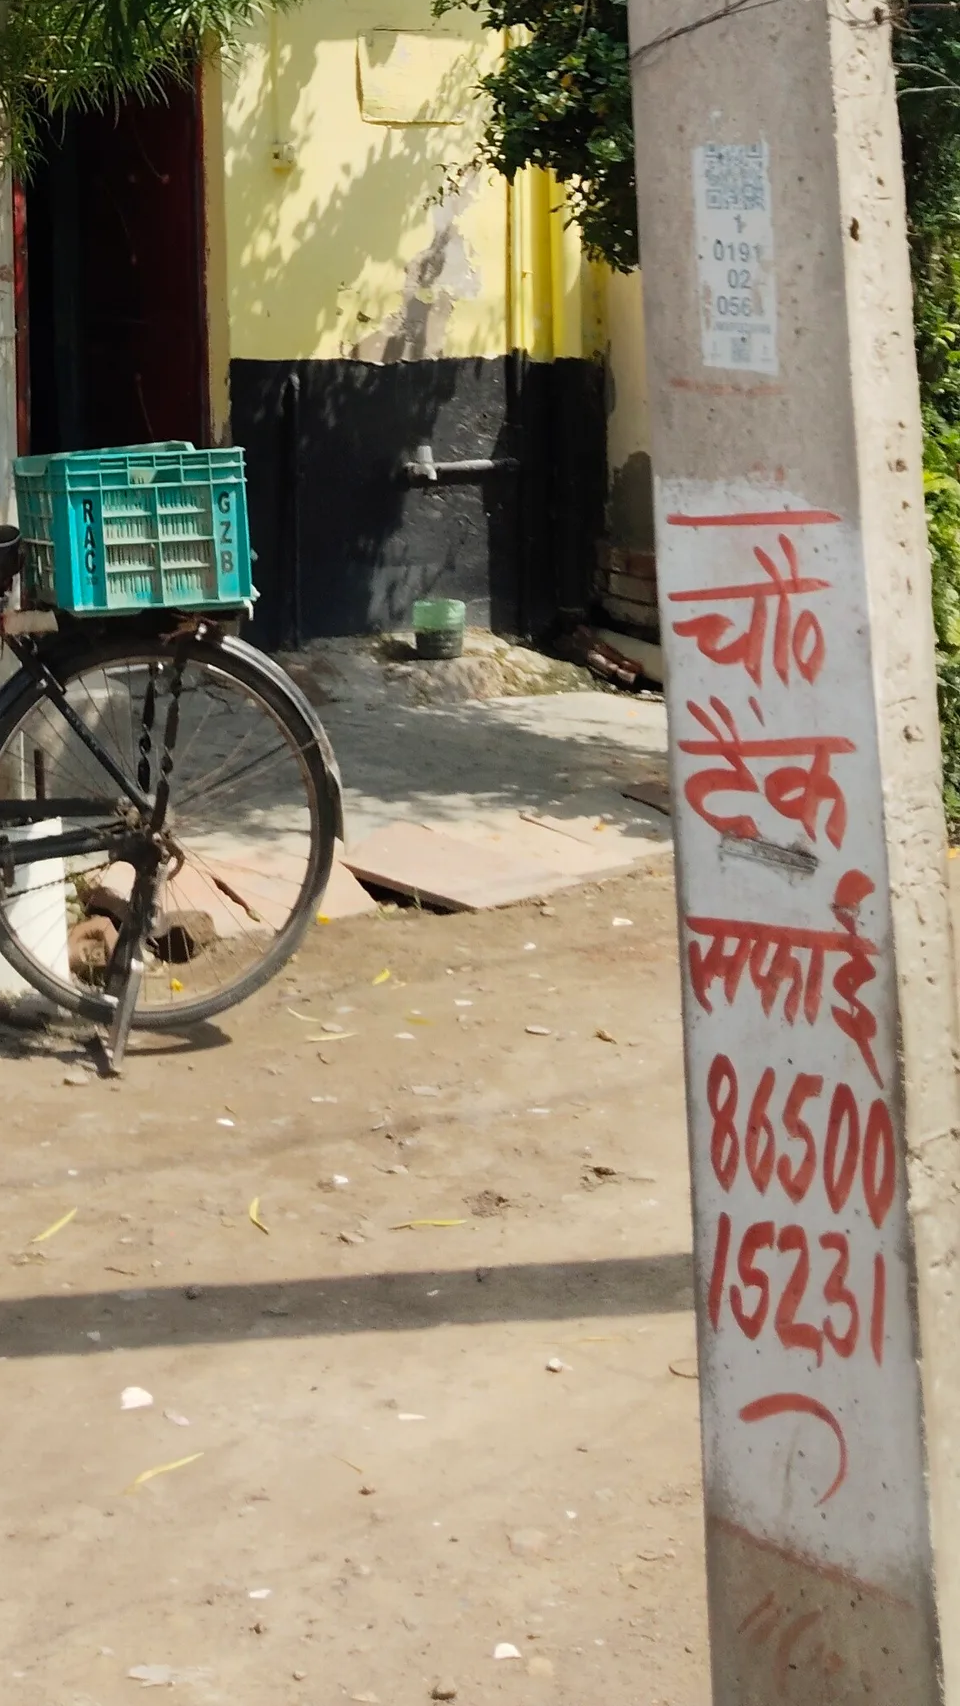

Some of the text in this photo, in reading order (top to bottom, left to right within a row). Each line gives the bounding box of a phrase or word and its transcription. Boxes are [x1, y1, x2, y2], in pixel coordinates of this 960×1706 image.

[727, 268, 752, 290] 02
[217, 490, 235, 575] GZB
[684, 868, 886, 1090] सफाई
[706, 1052, 897, 1229] 86500
[707, 1211, 887, 1368] 15231
